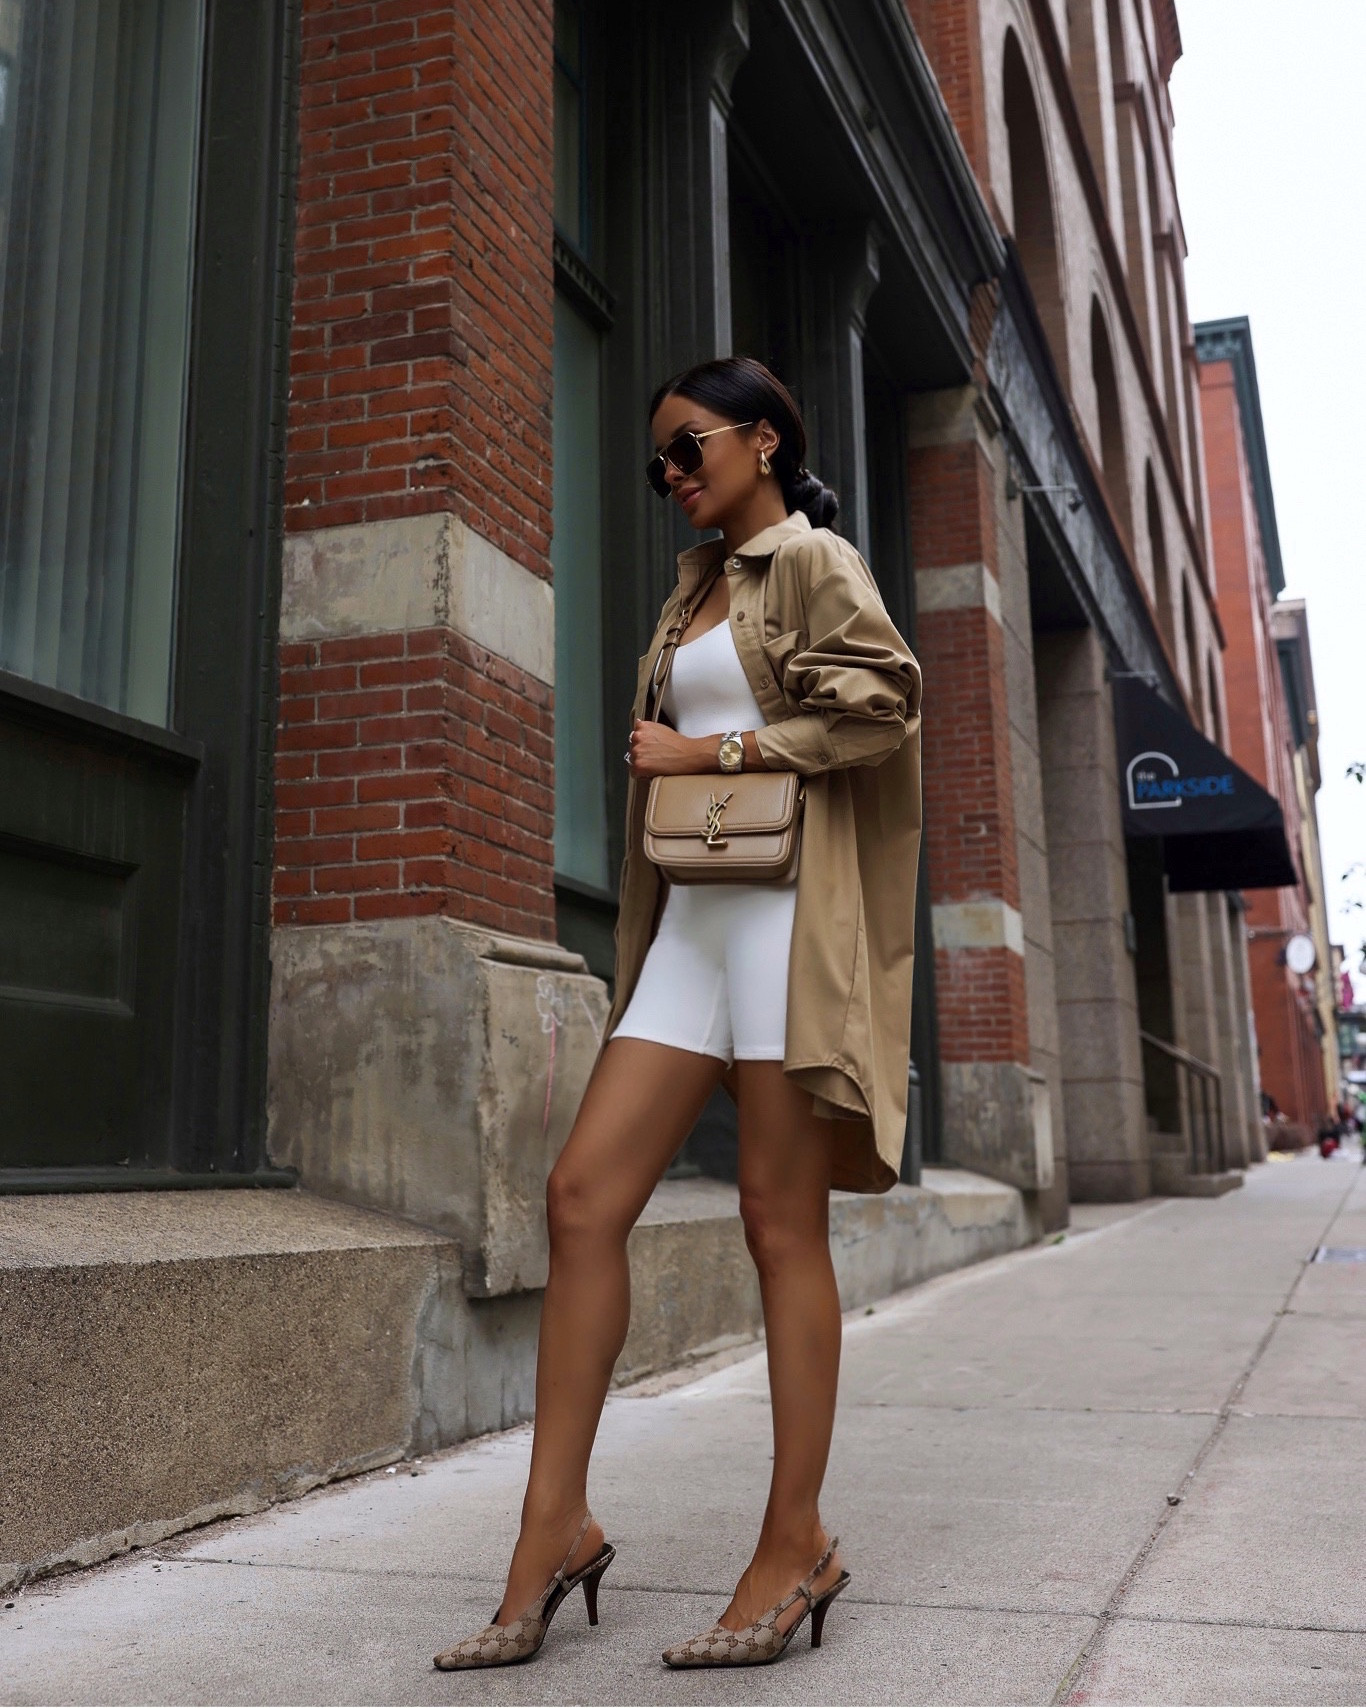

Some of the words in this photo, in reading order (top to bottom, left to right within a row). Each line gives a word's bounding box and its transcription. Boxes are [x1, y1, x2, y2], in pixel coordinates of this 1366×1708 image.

[1136, 770, 1156, 782] the
[1136, 774, 1234, 798] PARKSIDE
[699, 791, 733, 844] YSL
